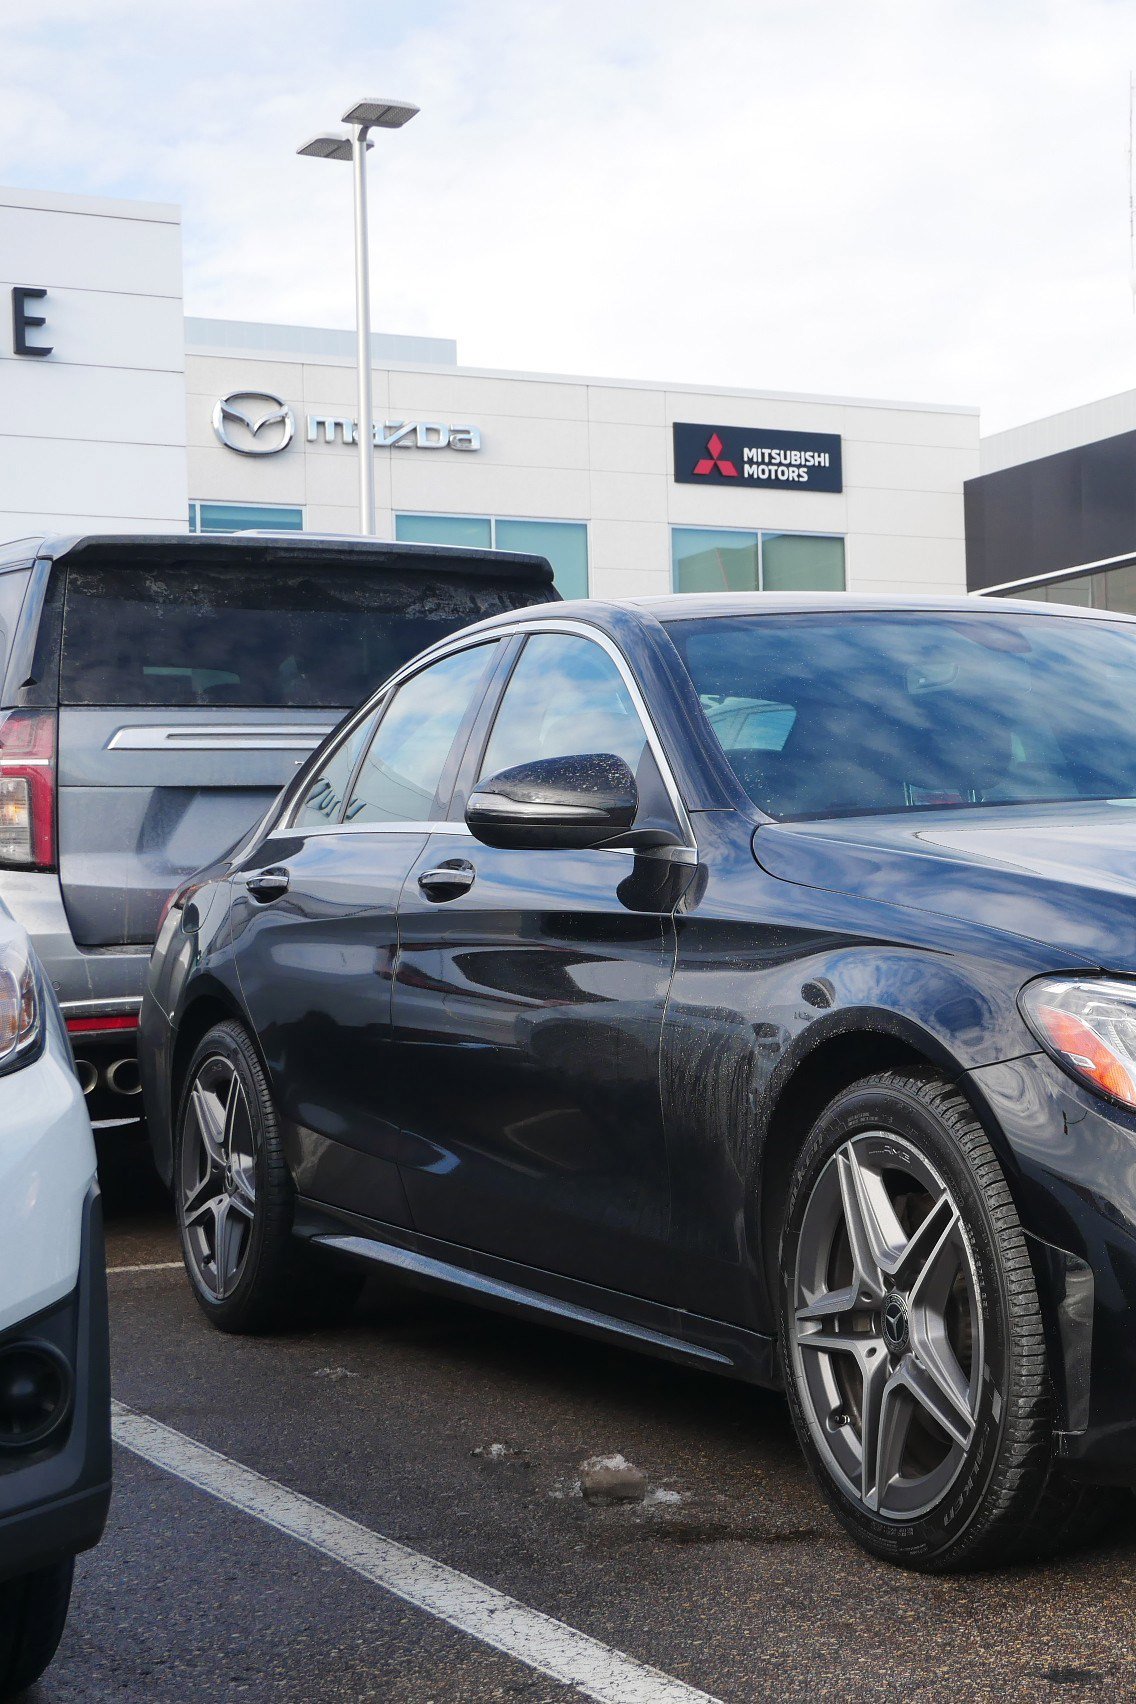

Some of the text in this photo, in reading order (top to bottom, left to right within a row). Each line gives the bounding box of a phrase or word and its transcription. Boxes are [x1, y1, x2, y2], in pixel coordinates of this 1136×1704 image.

[12, 287, 54, 356] E
[743, 447, 830, 467] MITSUBISHI
[744, 464, 809, 482] MOTORS
